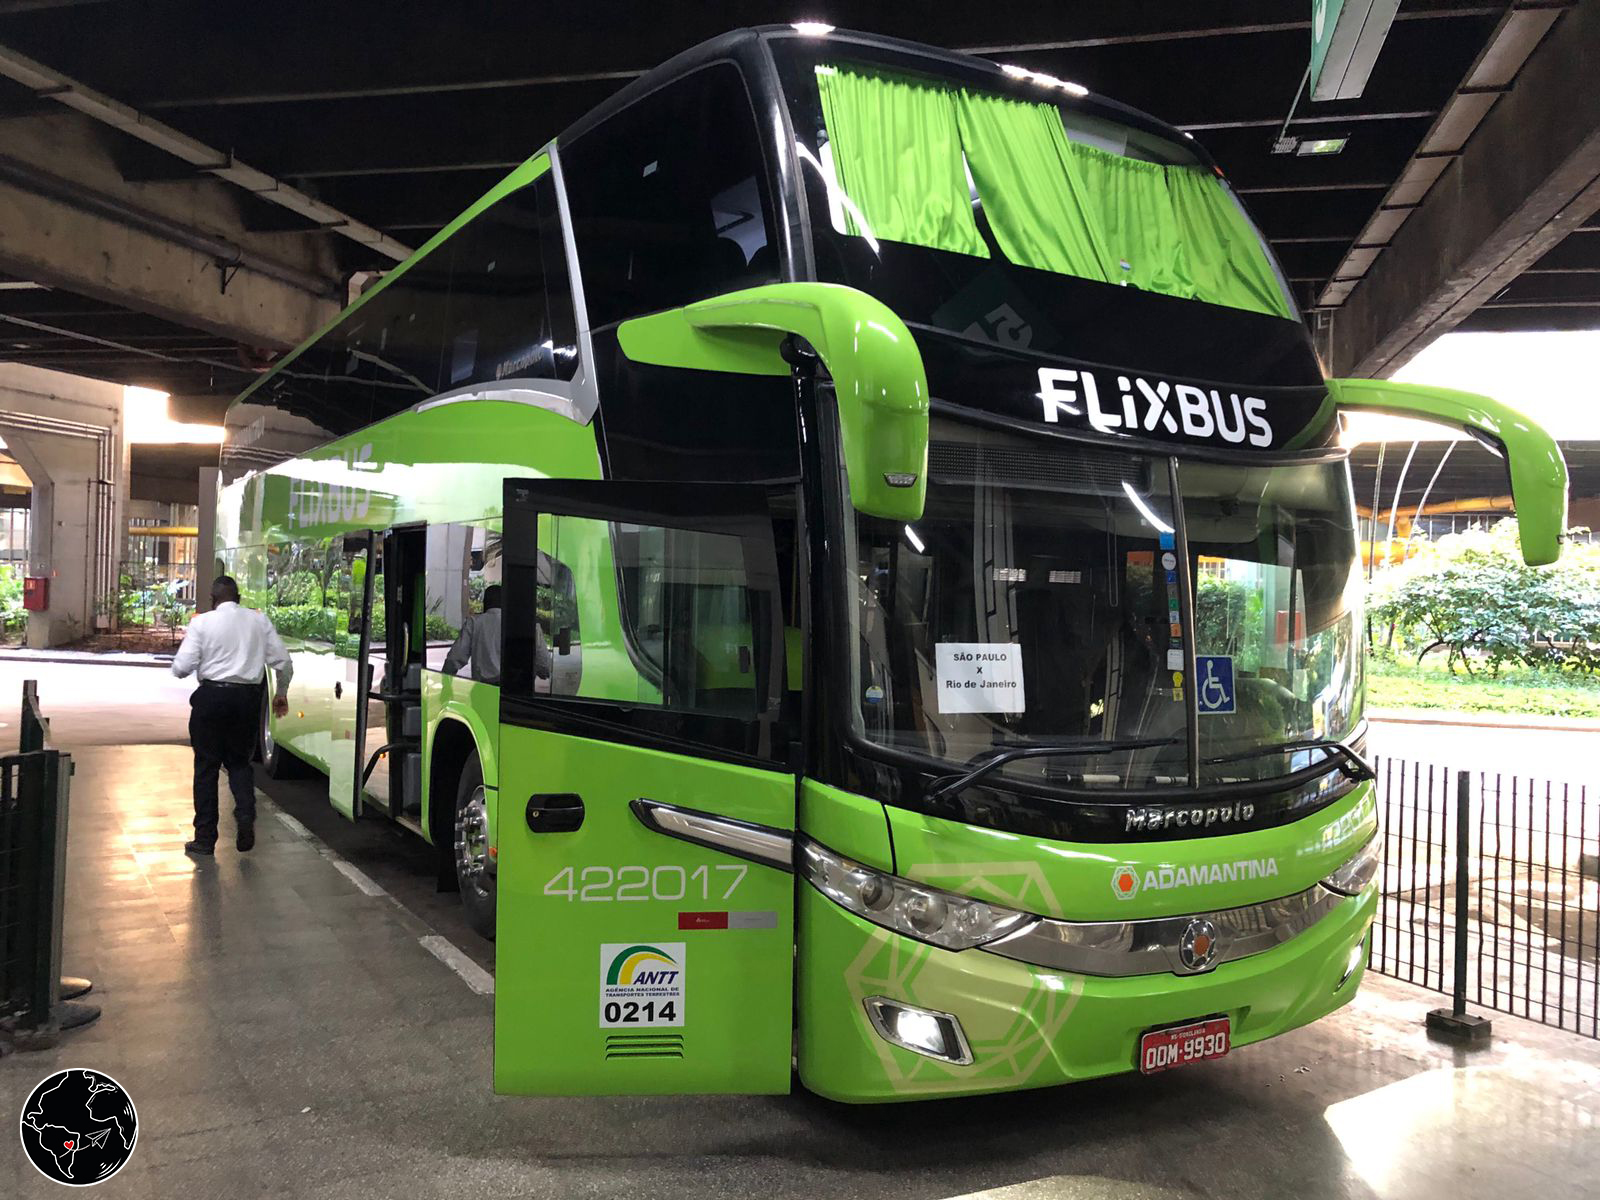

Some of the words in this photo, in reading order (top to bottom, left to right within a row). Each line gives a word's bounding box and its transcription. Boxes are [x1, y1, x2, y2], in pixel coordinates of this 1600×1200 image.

[953, 652, 973, 661] SÃO
[976, 653, 1007, 661] PAULO
[946, 680, 962, 688] Rio
[964, 680, 977, 688] de
[979, 680, 1017, 688] Janeiro
[1125, 801, 1255, 832] Marcopolo
[543, 864, 748, 902] 422017
[1142, 857, 1279, 891] ADAMANTINA
[633, 971, 679, 985] ANTT
[604, 1001, 677, 1023] 0214
